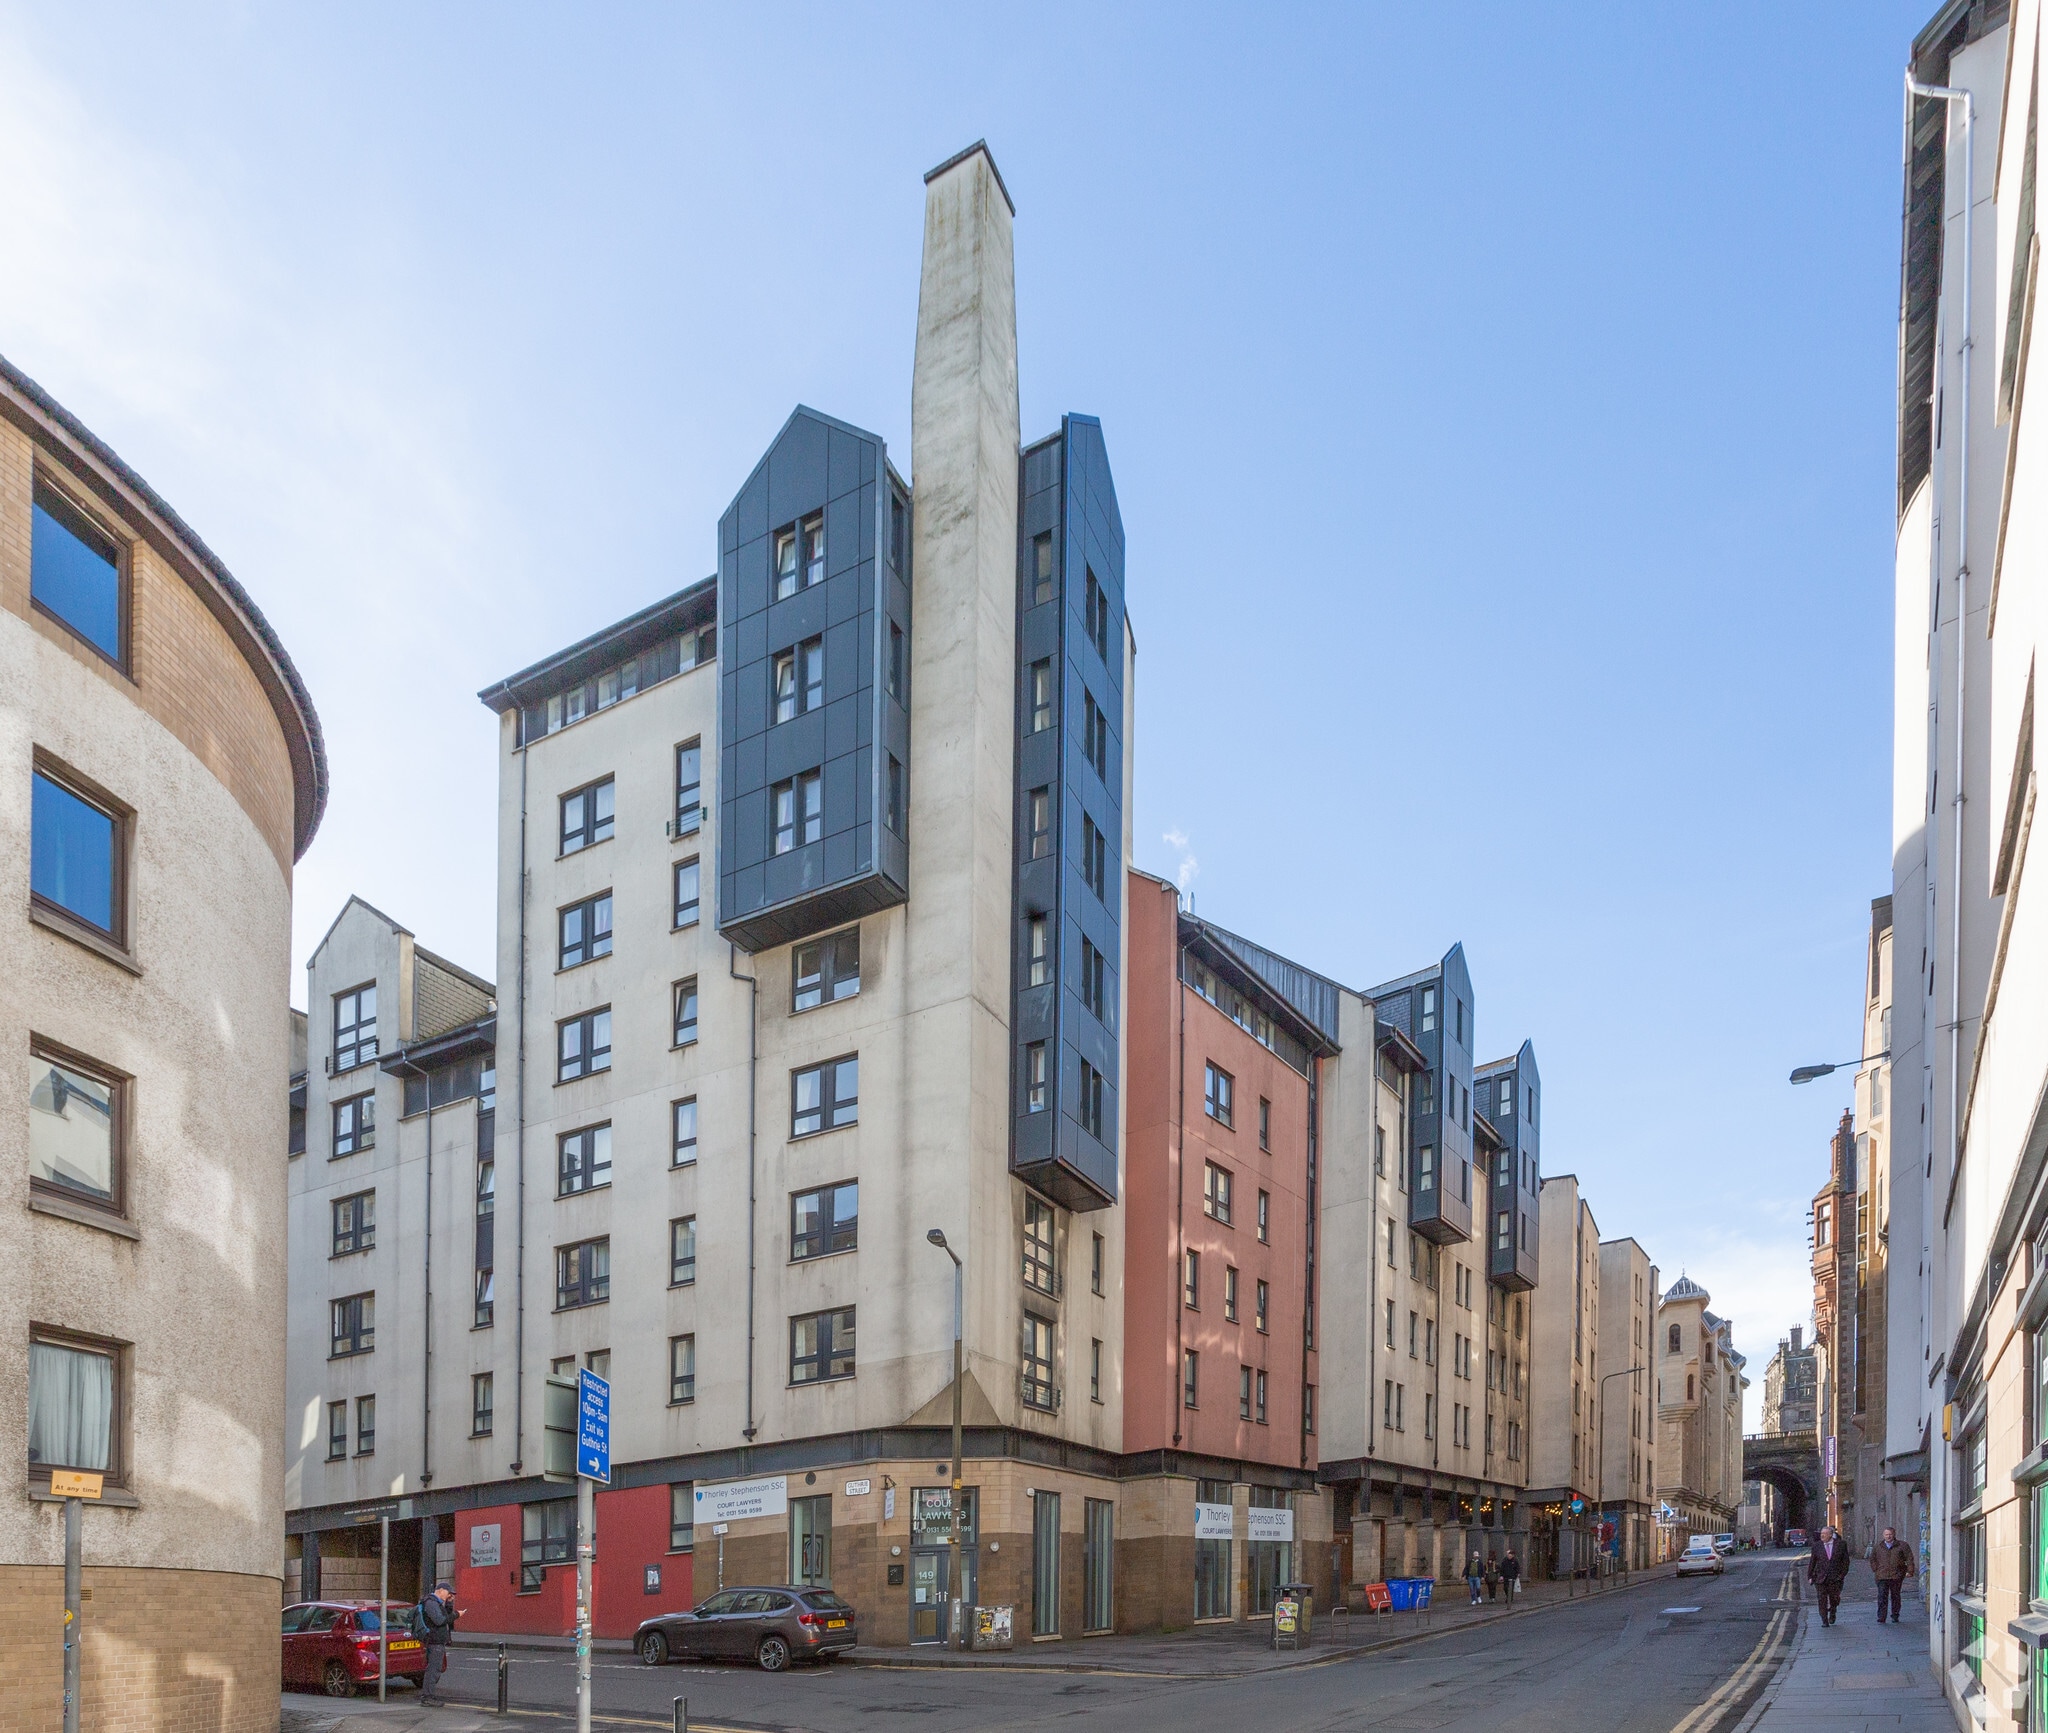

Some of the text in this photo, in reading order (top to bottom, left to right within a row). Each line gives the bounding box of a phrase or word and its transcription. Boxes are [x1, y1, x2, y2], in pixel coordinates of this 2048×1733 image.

[582, 1374, 608, 1397] Restricted
[587, 1392, 604, 1407] access
[582, 1402, 608, 1423] 10pm-5am
[586, 1420, 596, 1434] Exit
[581, 1433, 607, 1454] Guthrie St
[704, 1481, 784, 1499] Thorley Stephenson SSC
[736, 1499, 762, 1507] LAWYERS
[920, 1510, 967, 1520] LAWYES
[1207, 1509, 1286, 1525] Thorley ephenson SSC
[919, 1570, 934, 1580] 149
